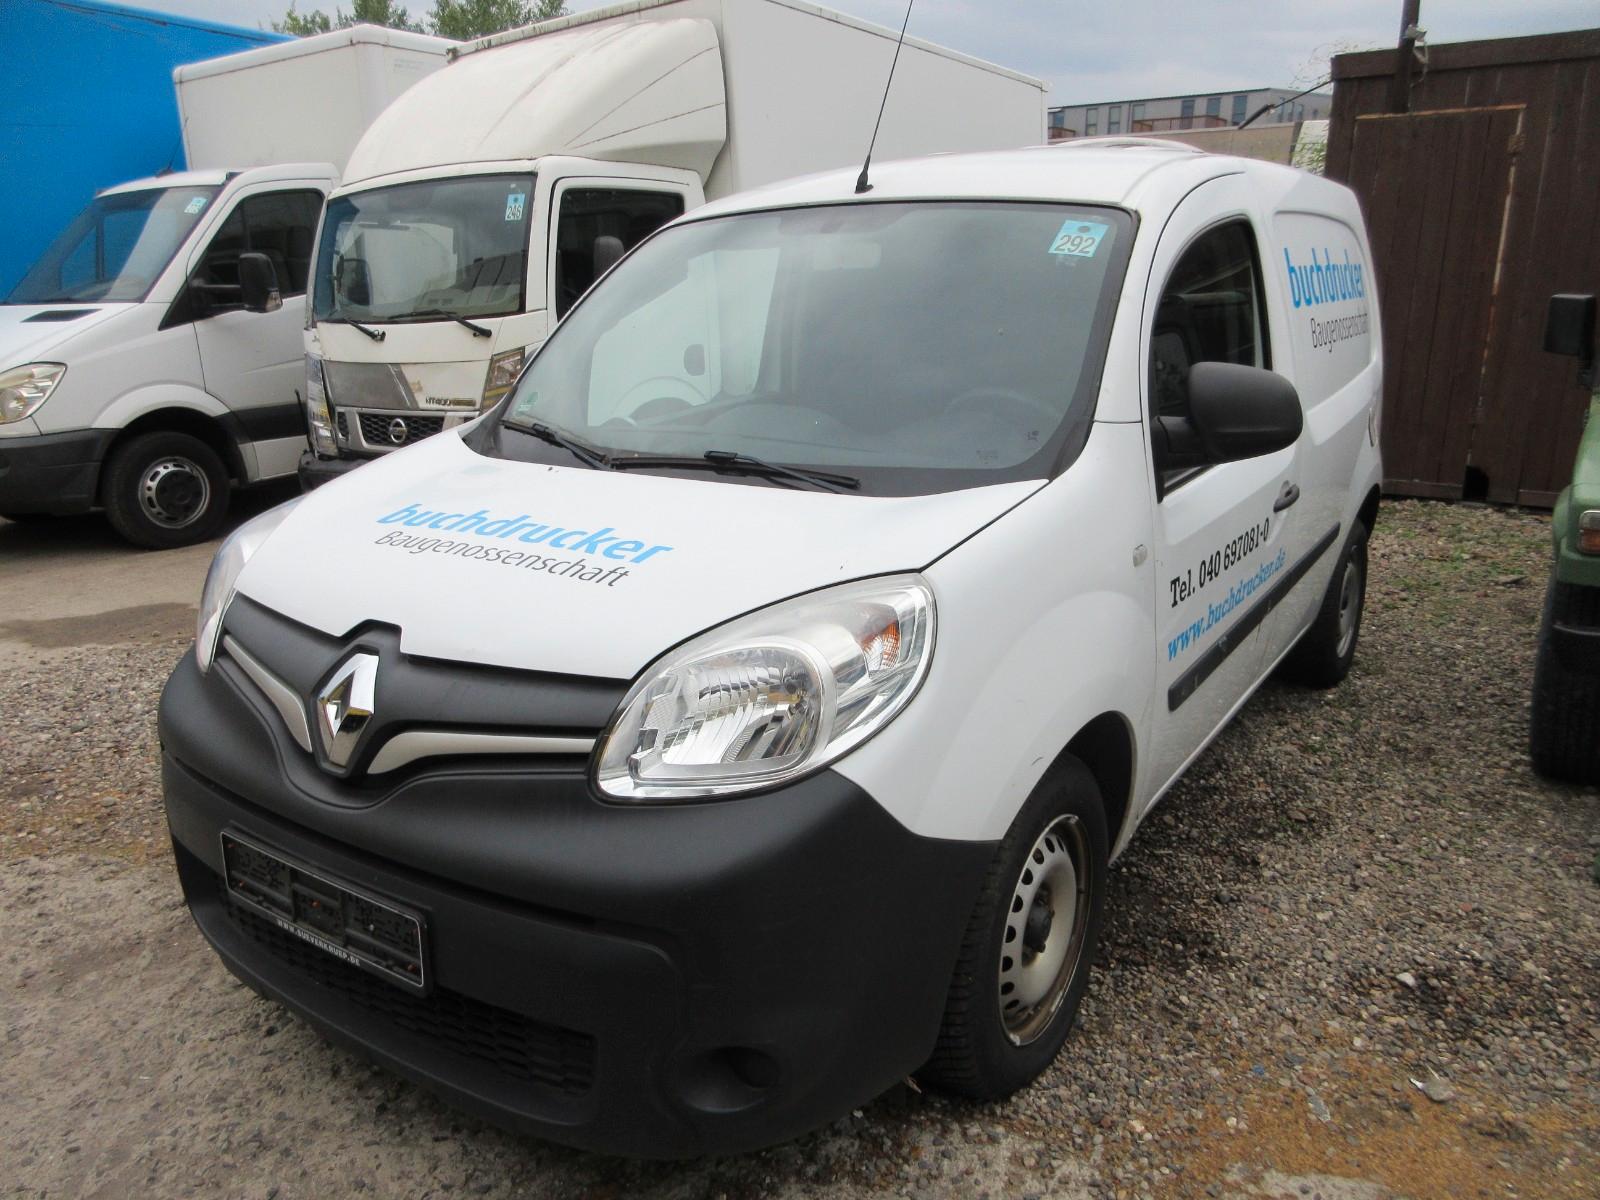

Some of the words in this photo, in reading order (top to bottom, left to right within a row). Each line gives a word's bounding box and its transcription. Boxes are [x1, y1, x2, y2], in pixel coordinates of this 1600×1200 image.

[1054, 234, 1096, 254] 292
[1283, 247, 1365, 309] buchdrucker
[374, 530, 630, 587] Baugenossenschaft
[375, 503, 674, 564] buchdrucker
[1170, 569, 1196, 608] Tel.
[1199, 550, 1221, 589] 040
[1223, 517, 1270, 571] 697081-0
[1167, 546, 1287, 662] www.buchdrucker.de
